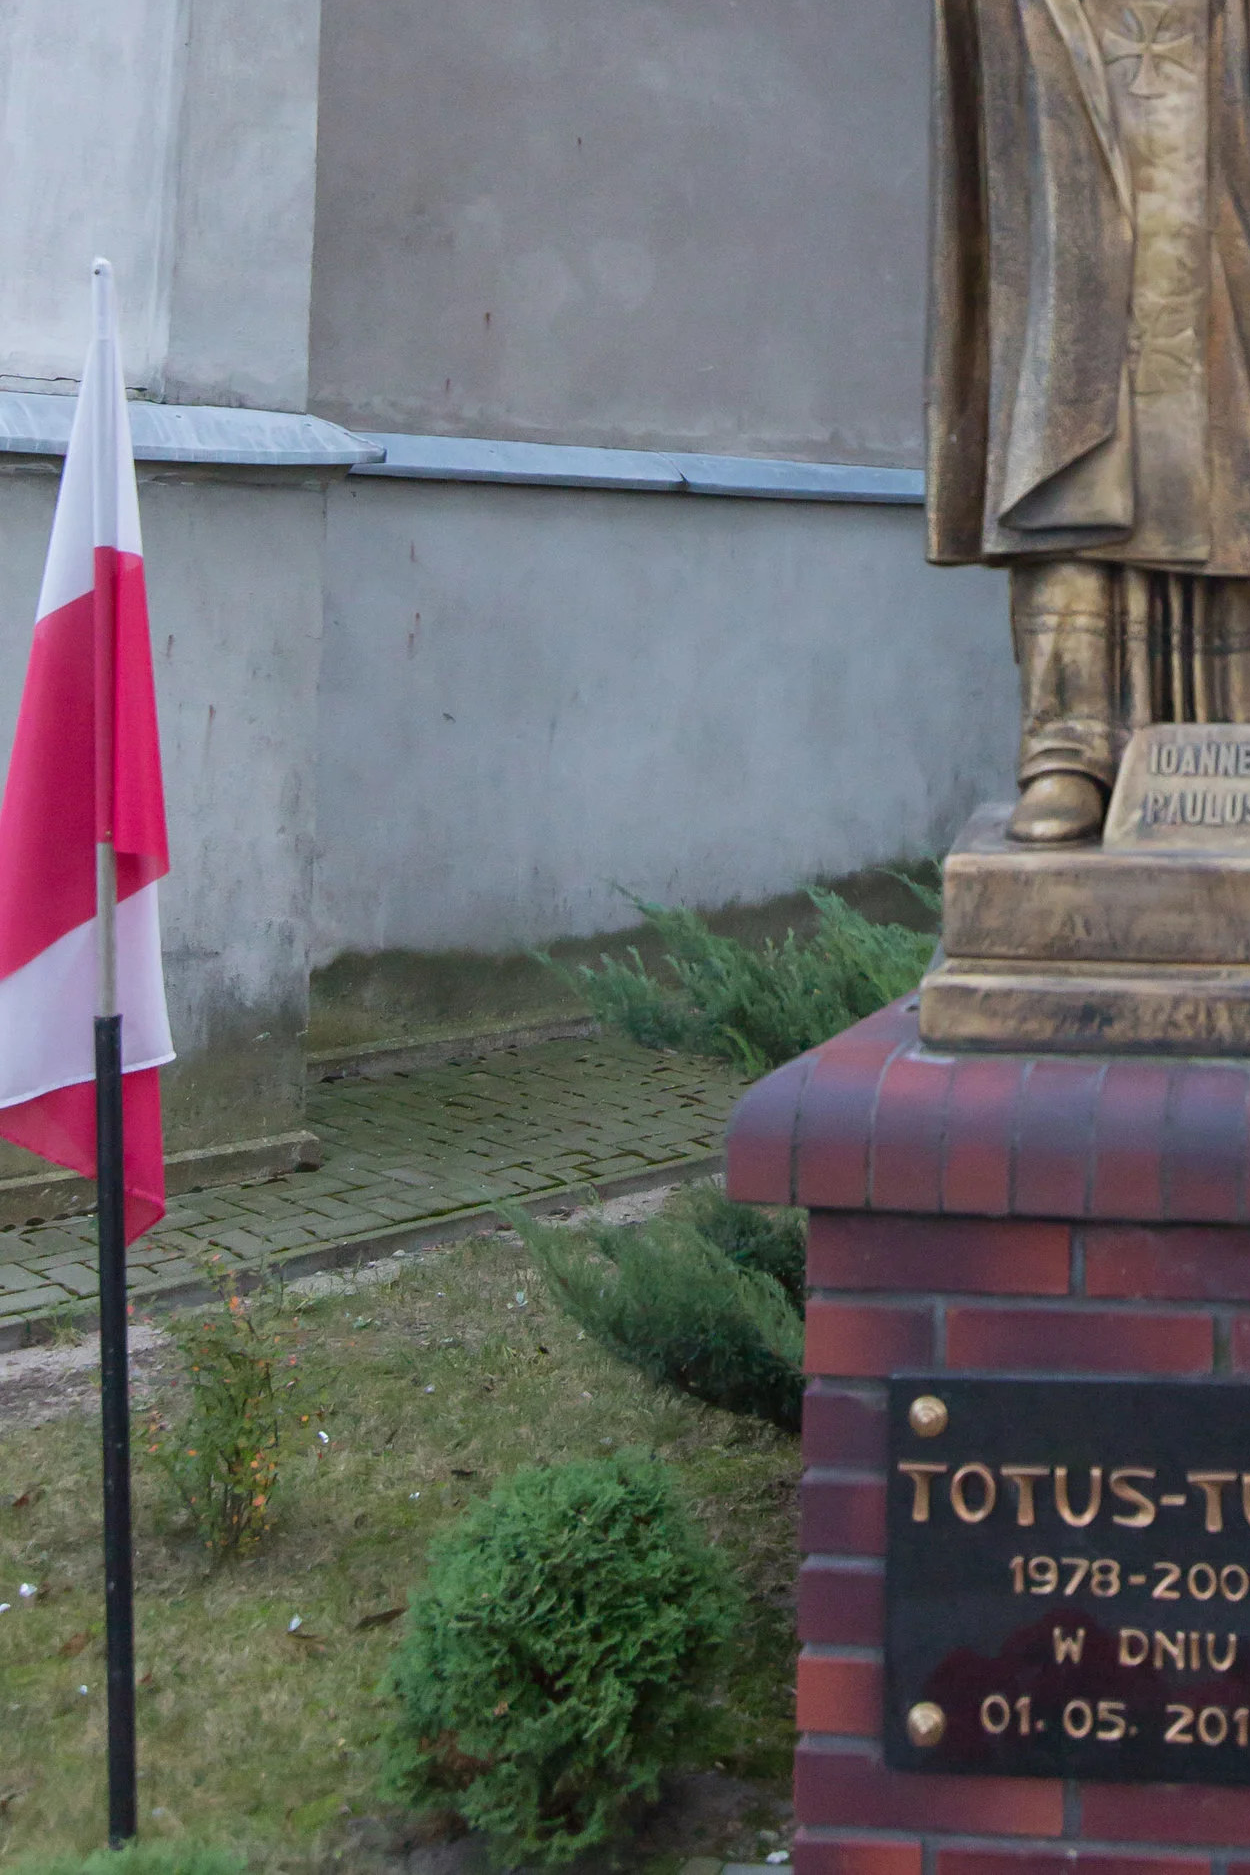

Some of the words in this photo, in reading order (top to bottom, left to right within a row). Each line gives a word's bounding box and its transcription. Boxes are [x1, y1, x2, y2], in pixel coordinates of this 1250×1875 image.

[1052, 1625, 1086, 1665] W
[1118, 1626, 1239, 1672] DNIU
[979, 1693, 1046, 1737] 01.
[1061, 1698, 1138, 1741] 05.
